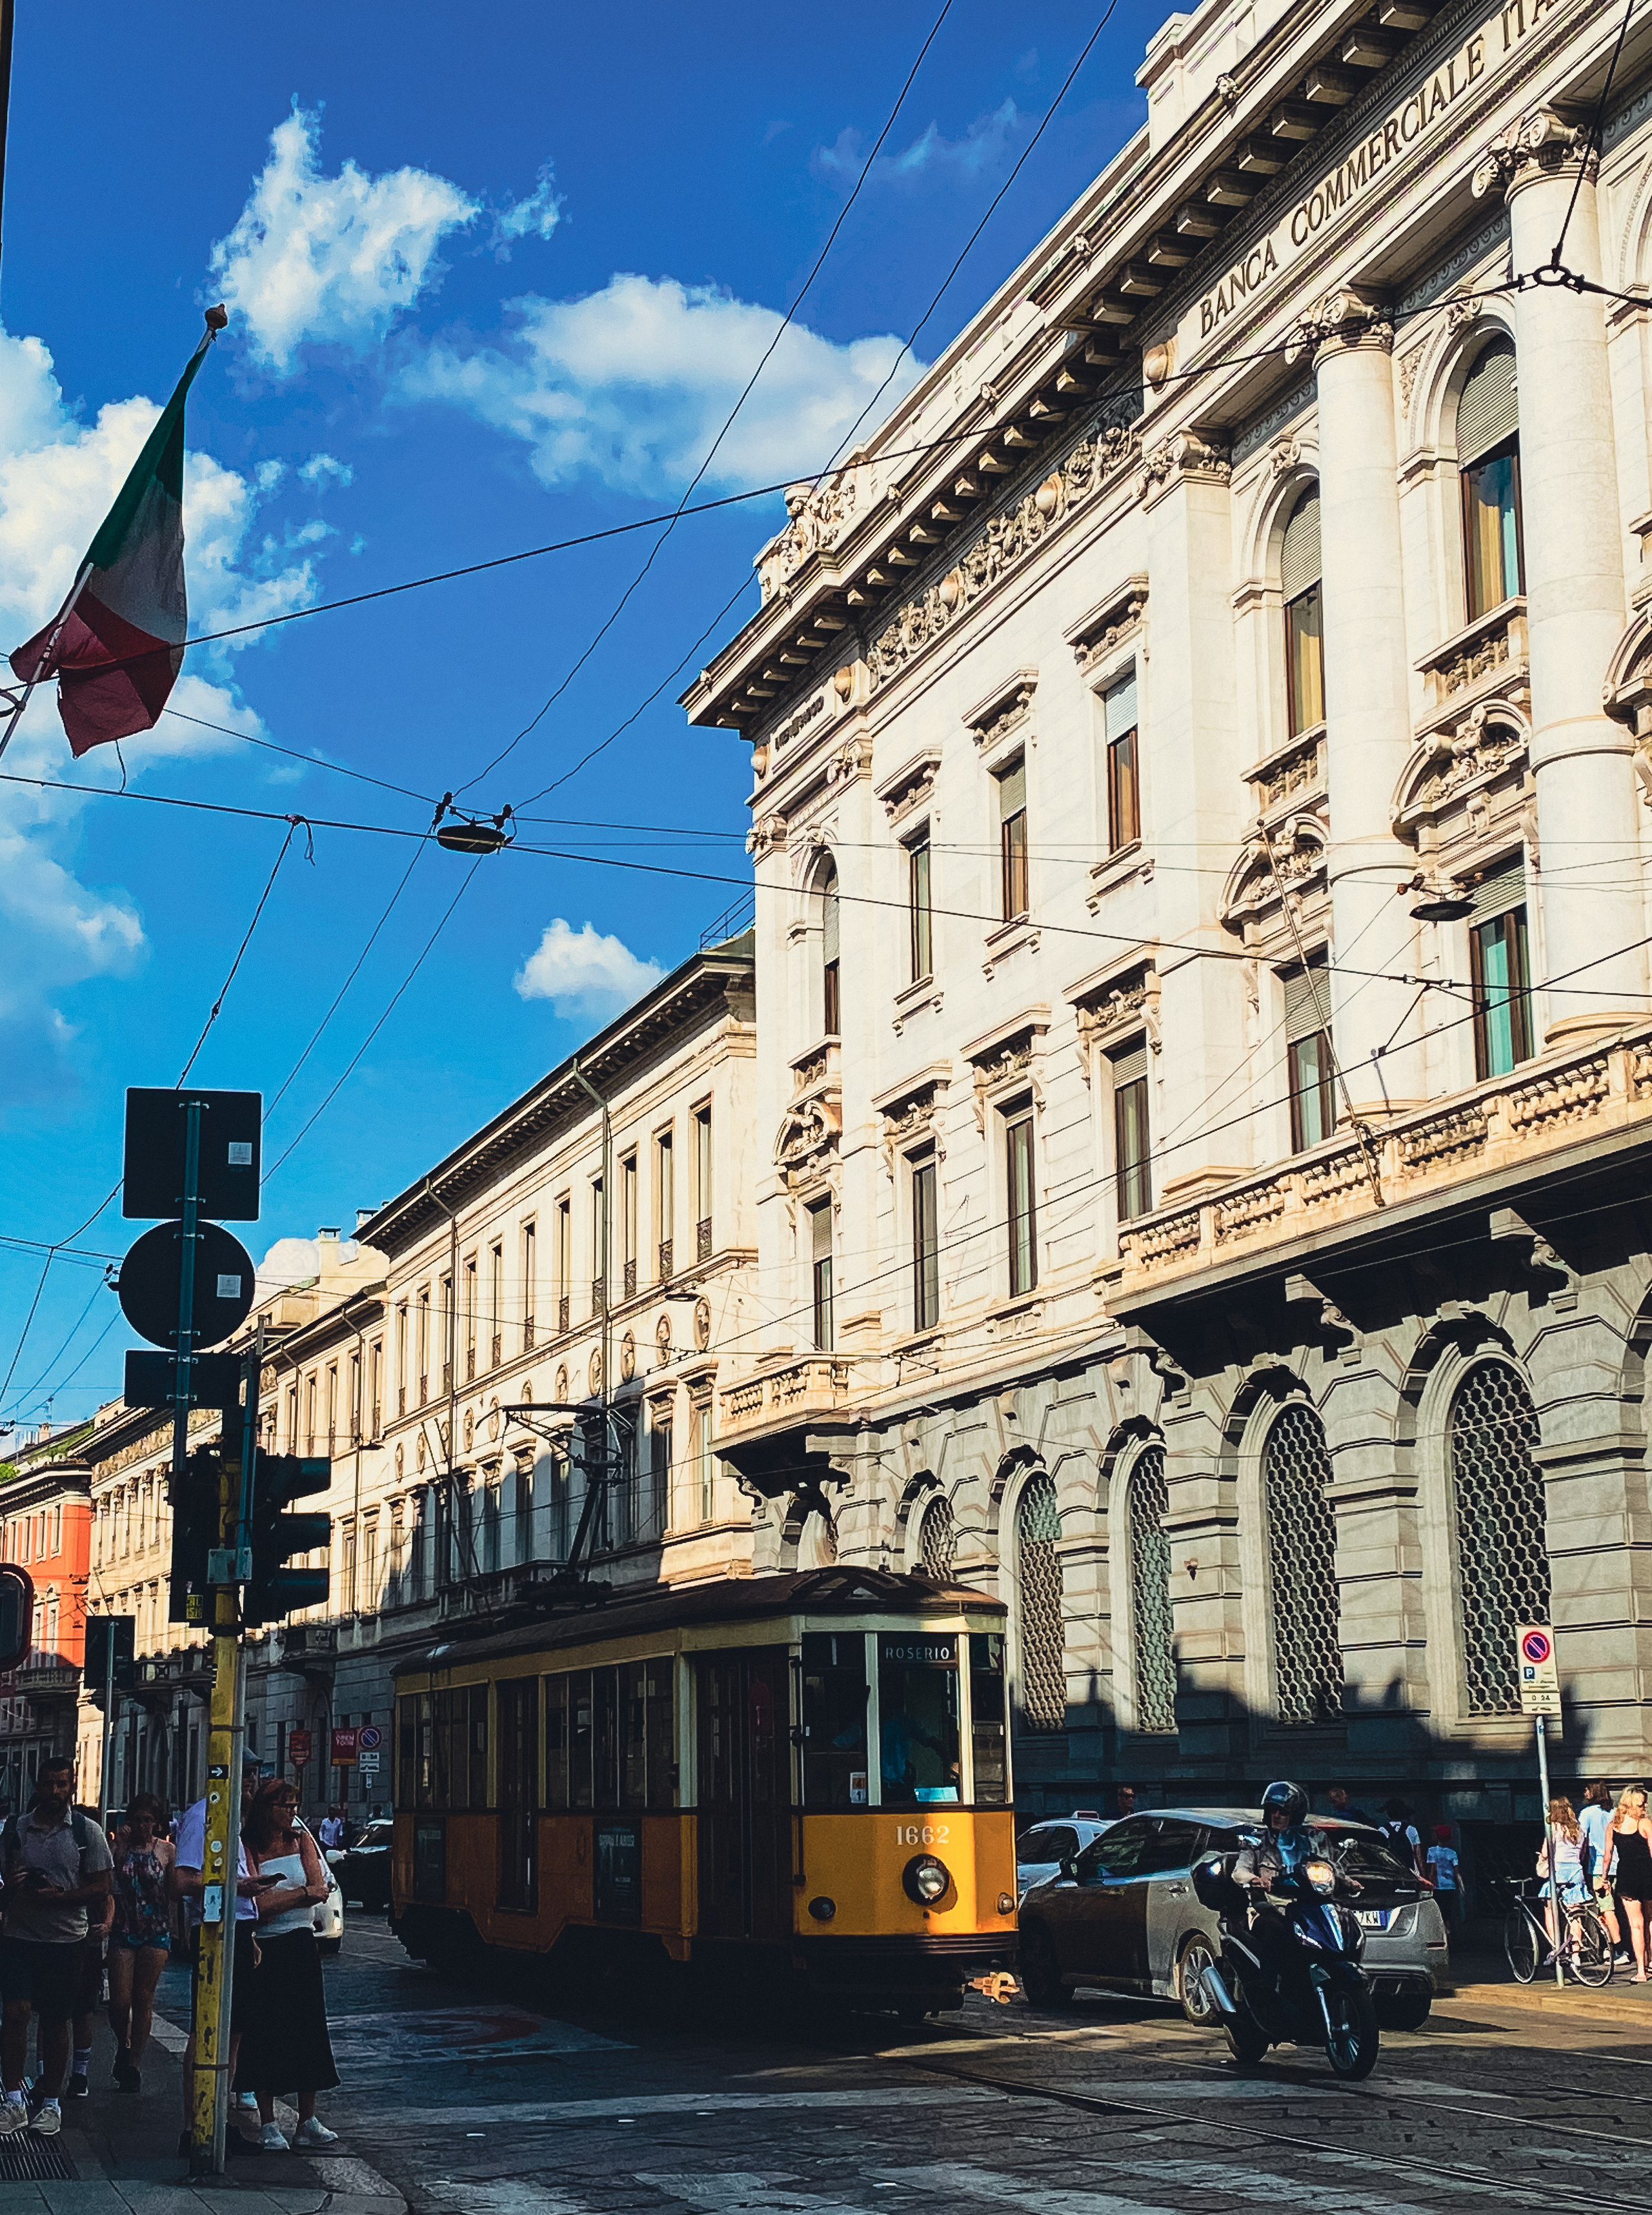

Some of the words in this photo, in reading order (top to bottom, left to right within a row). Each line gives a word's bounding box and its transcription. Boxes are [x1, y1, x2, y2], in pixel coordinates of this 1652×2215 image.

[1200, 239, 1279, 338] BANCA
[1291, 34, 1485, 247] COMMERCIALE
[885, 1647, 949, 1659] ROSERIO
[896, 1825, 949, 1845] 1662
